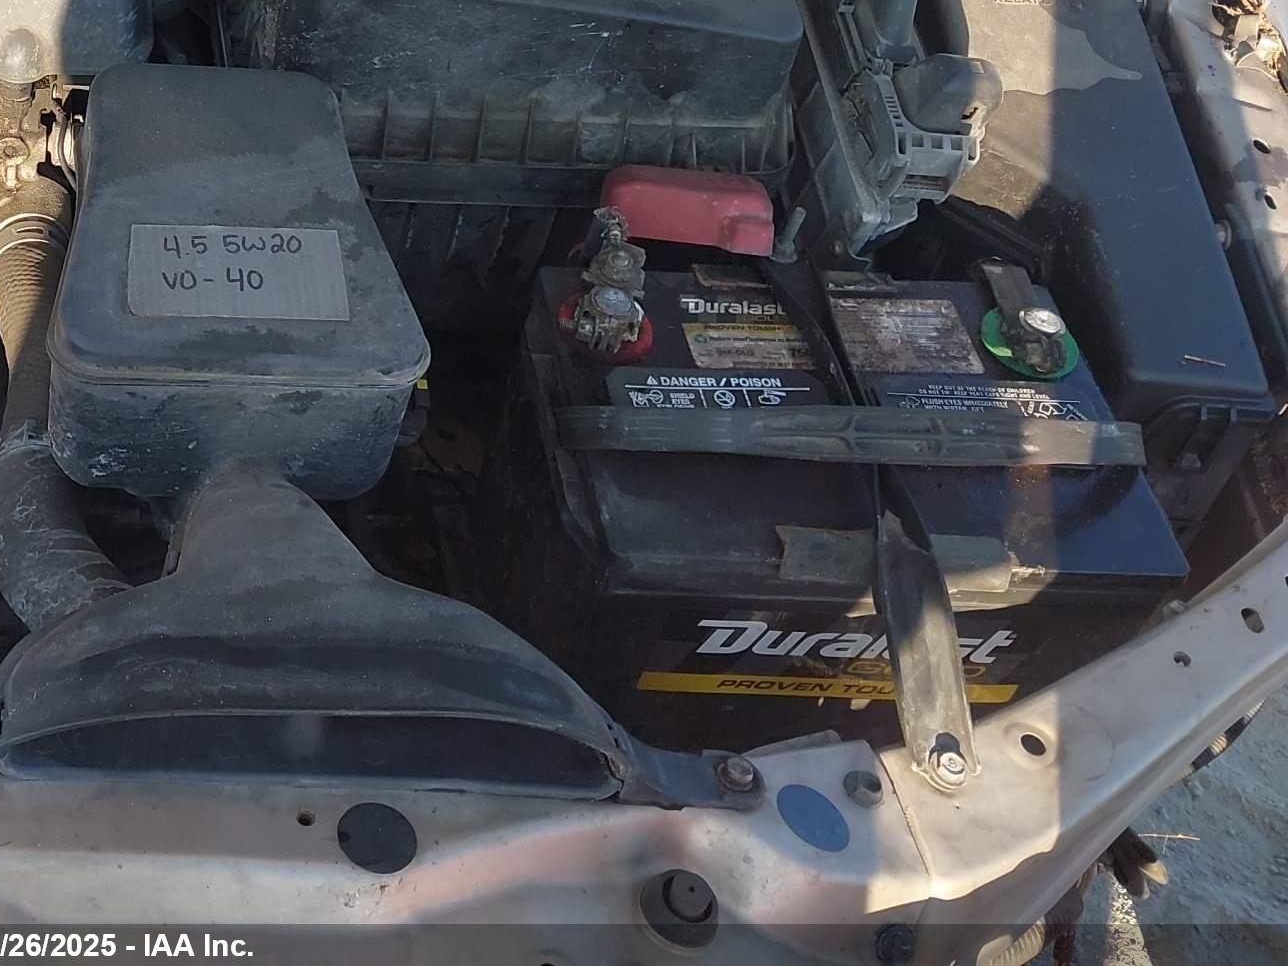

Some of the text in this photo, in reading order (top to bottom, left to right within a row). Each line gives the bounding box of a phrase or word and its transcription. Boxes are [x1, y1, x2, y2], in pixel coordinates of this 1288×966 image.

[163, 235, 208, 258] 4.5
[660, 376, 716, 386] DANGER
[731, 377, 782, 387] POISON
[717, 679, 835, 694] PROVEN
